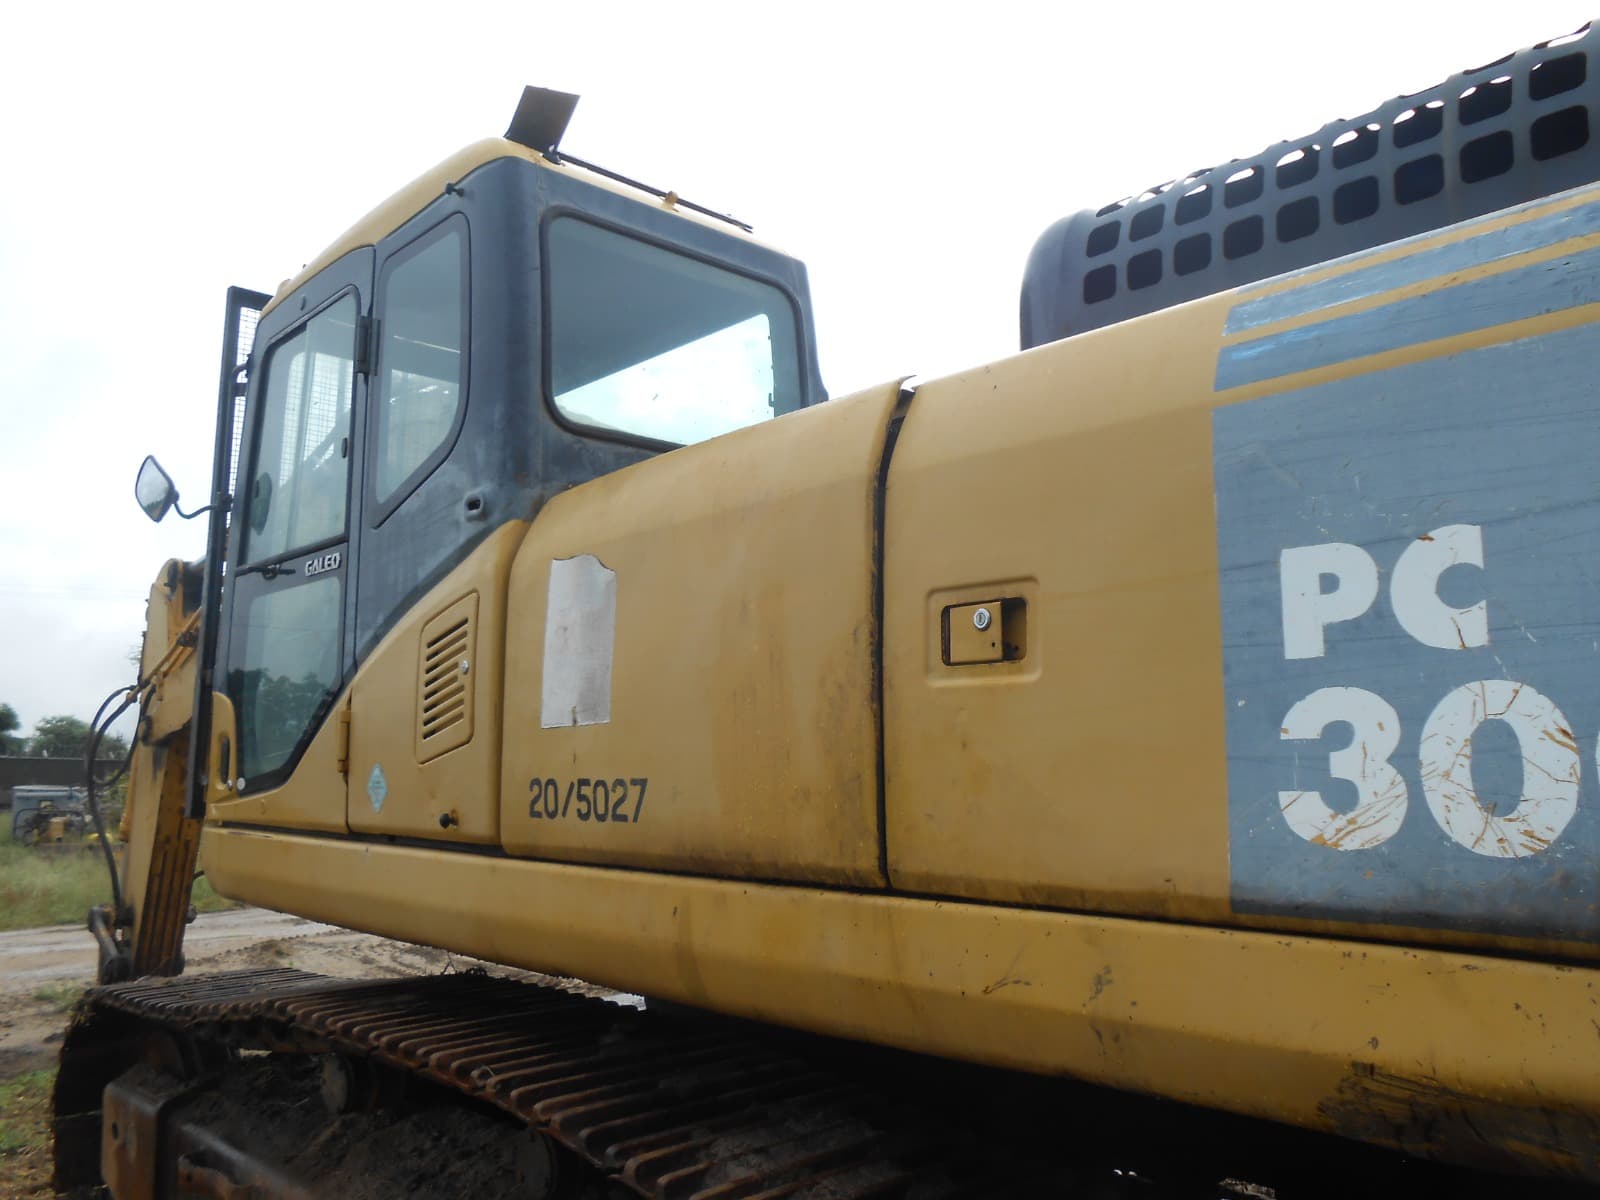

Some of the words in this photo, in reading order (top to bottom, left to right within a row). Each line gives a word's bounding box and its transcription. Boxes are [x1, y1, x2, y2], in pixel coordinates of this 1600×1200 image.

[305, 552, 341, 577] GALEO
[1280, 524, 1489, 660] PC
[529, 777, 648, 823] 20/5027
[1278, 679, 1600, 858] 30
